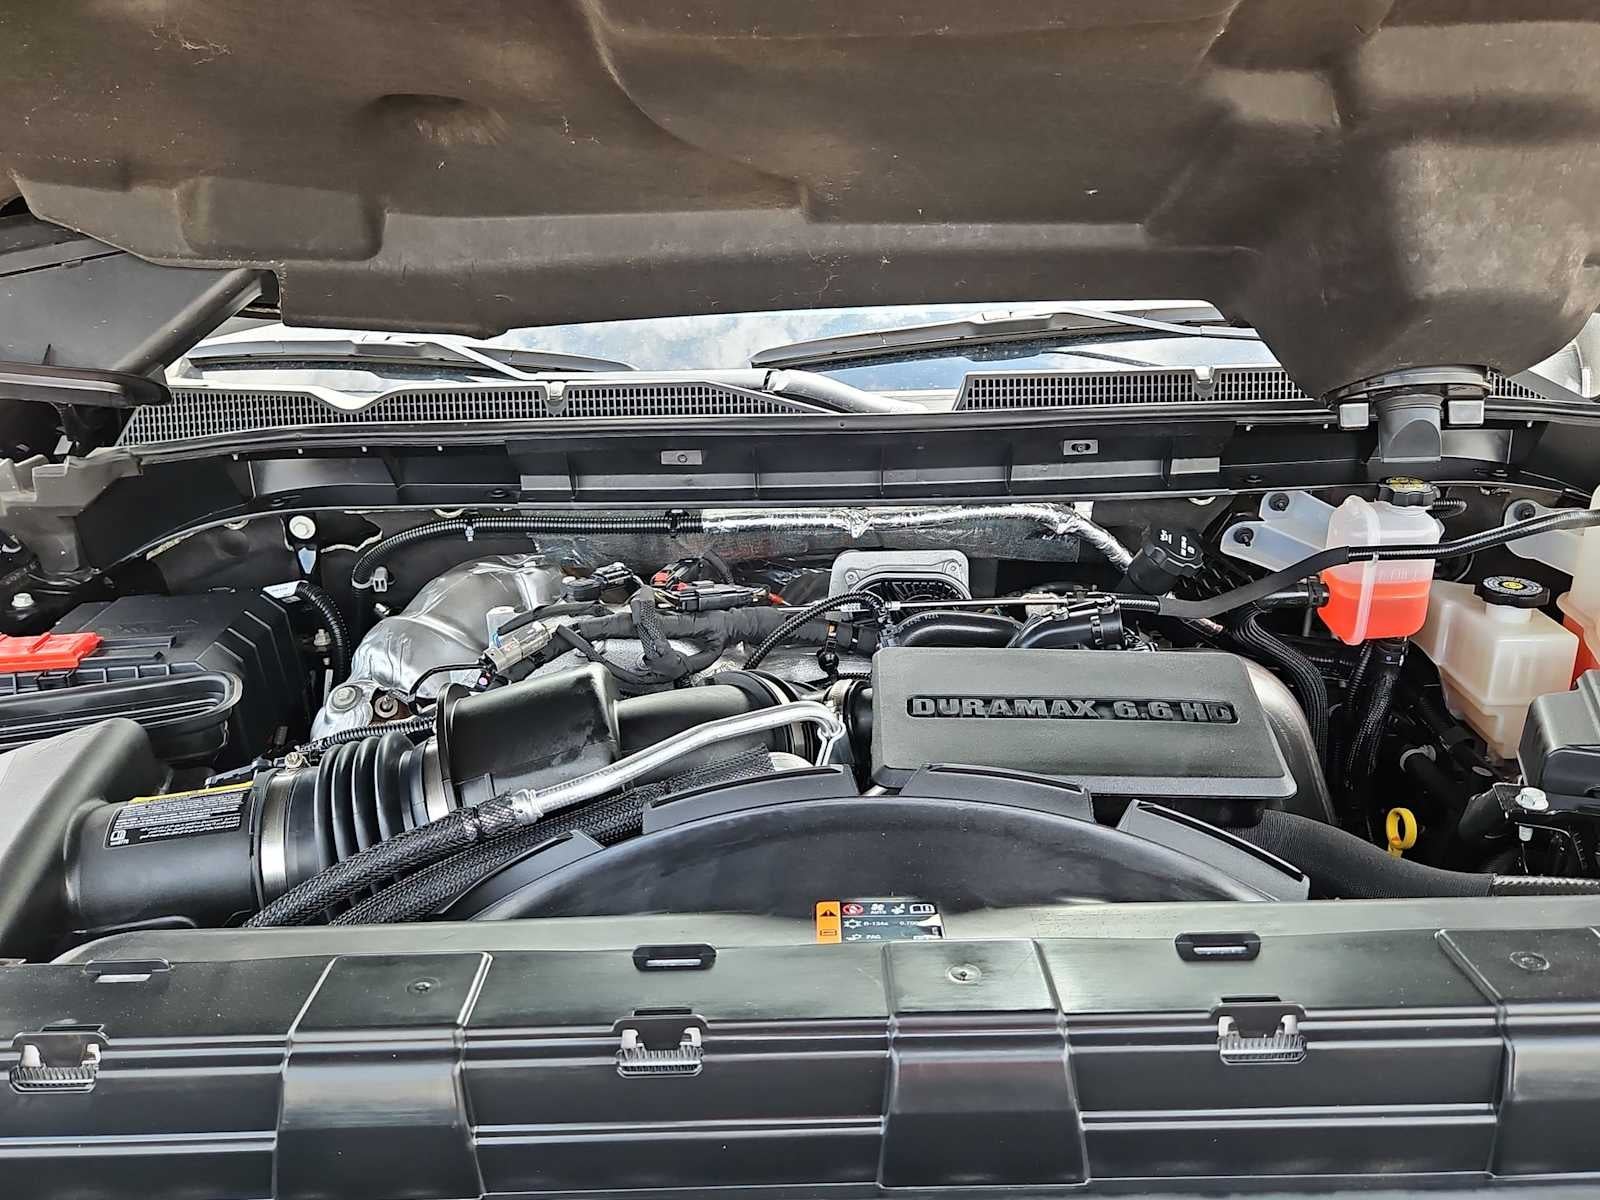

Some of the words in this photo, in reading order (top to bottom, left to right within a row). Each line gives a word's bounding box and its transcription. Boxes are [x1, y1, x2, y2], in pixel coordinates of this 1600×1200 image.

[912, 698, 1100, 717] DURAMAX
[1113, 701, 1174, 719] 6.6
[1180, 702, 1233, 721] HD
